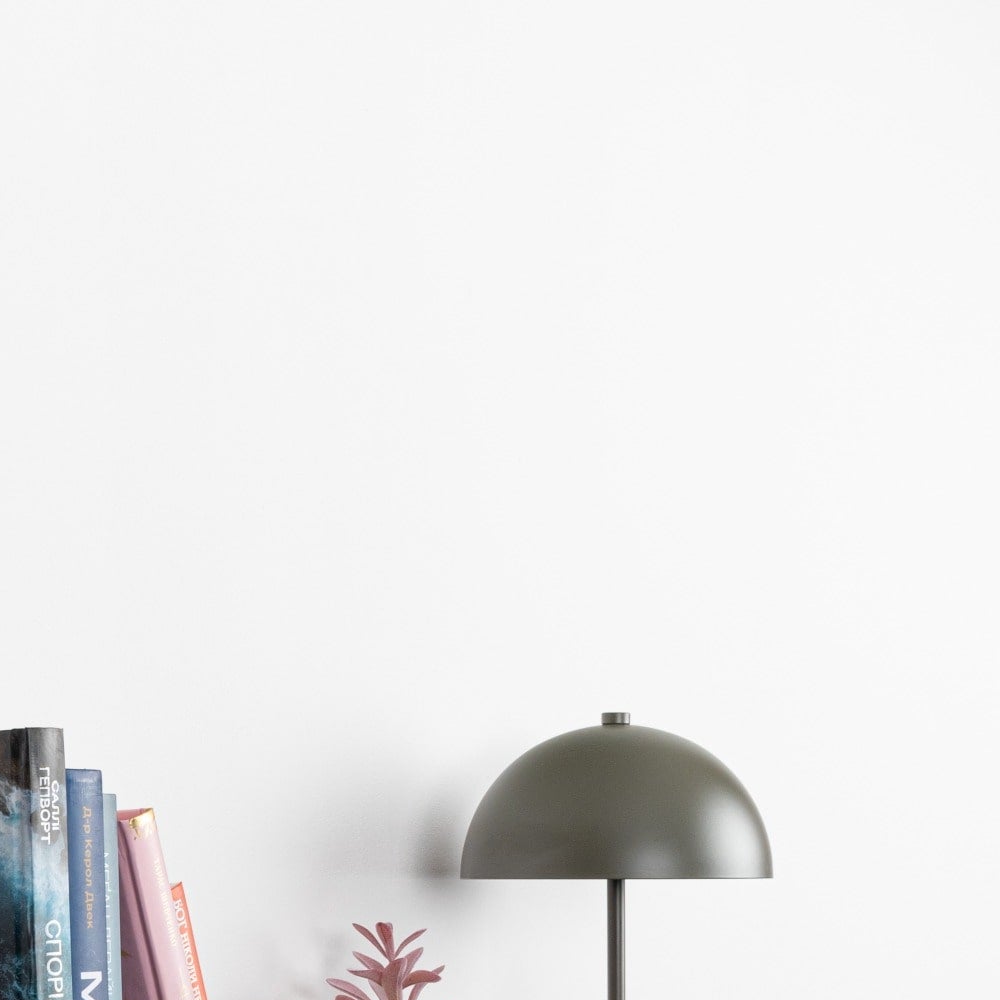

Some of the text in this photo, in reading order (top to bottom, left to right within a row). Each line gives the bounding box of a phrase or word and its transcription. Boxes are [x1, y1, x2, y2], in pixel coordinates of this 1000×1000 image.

[39, 767, 51, 845] ГЕПВОРТ
[51, 780, 60, 831] САЛЛІ
[83, 806, 94, 929] Д-р Керол Двек
[174, 899, 187, 929] БОГ
[180, 931, 198, 982] НІКОЛИ
